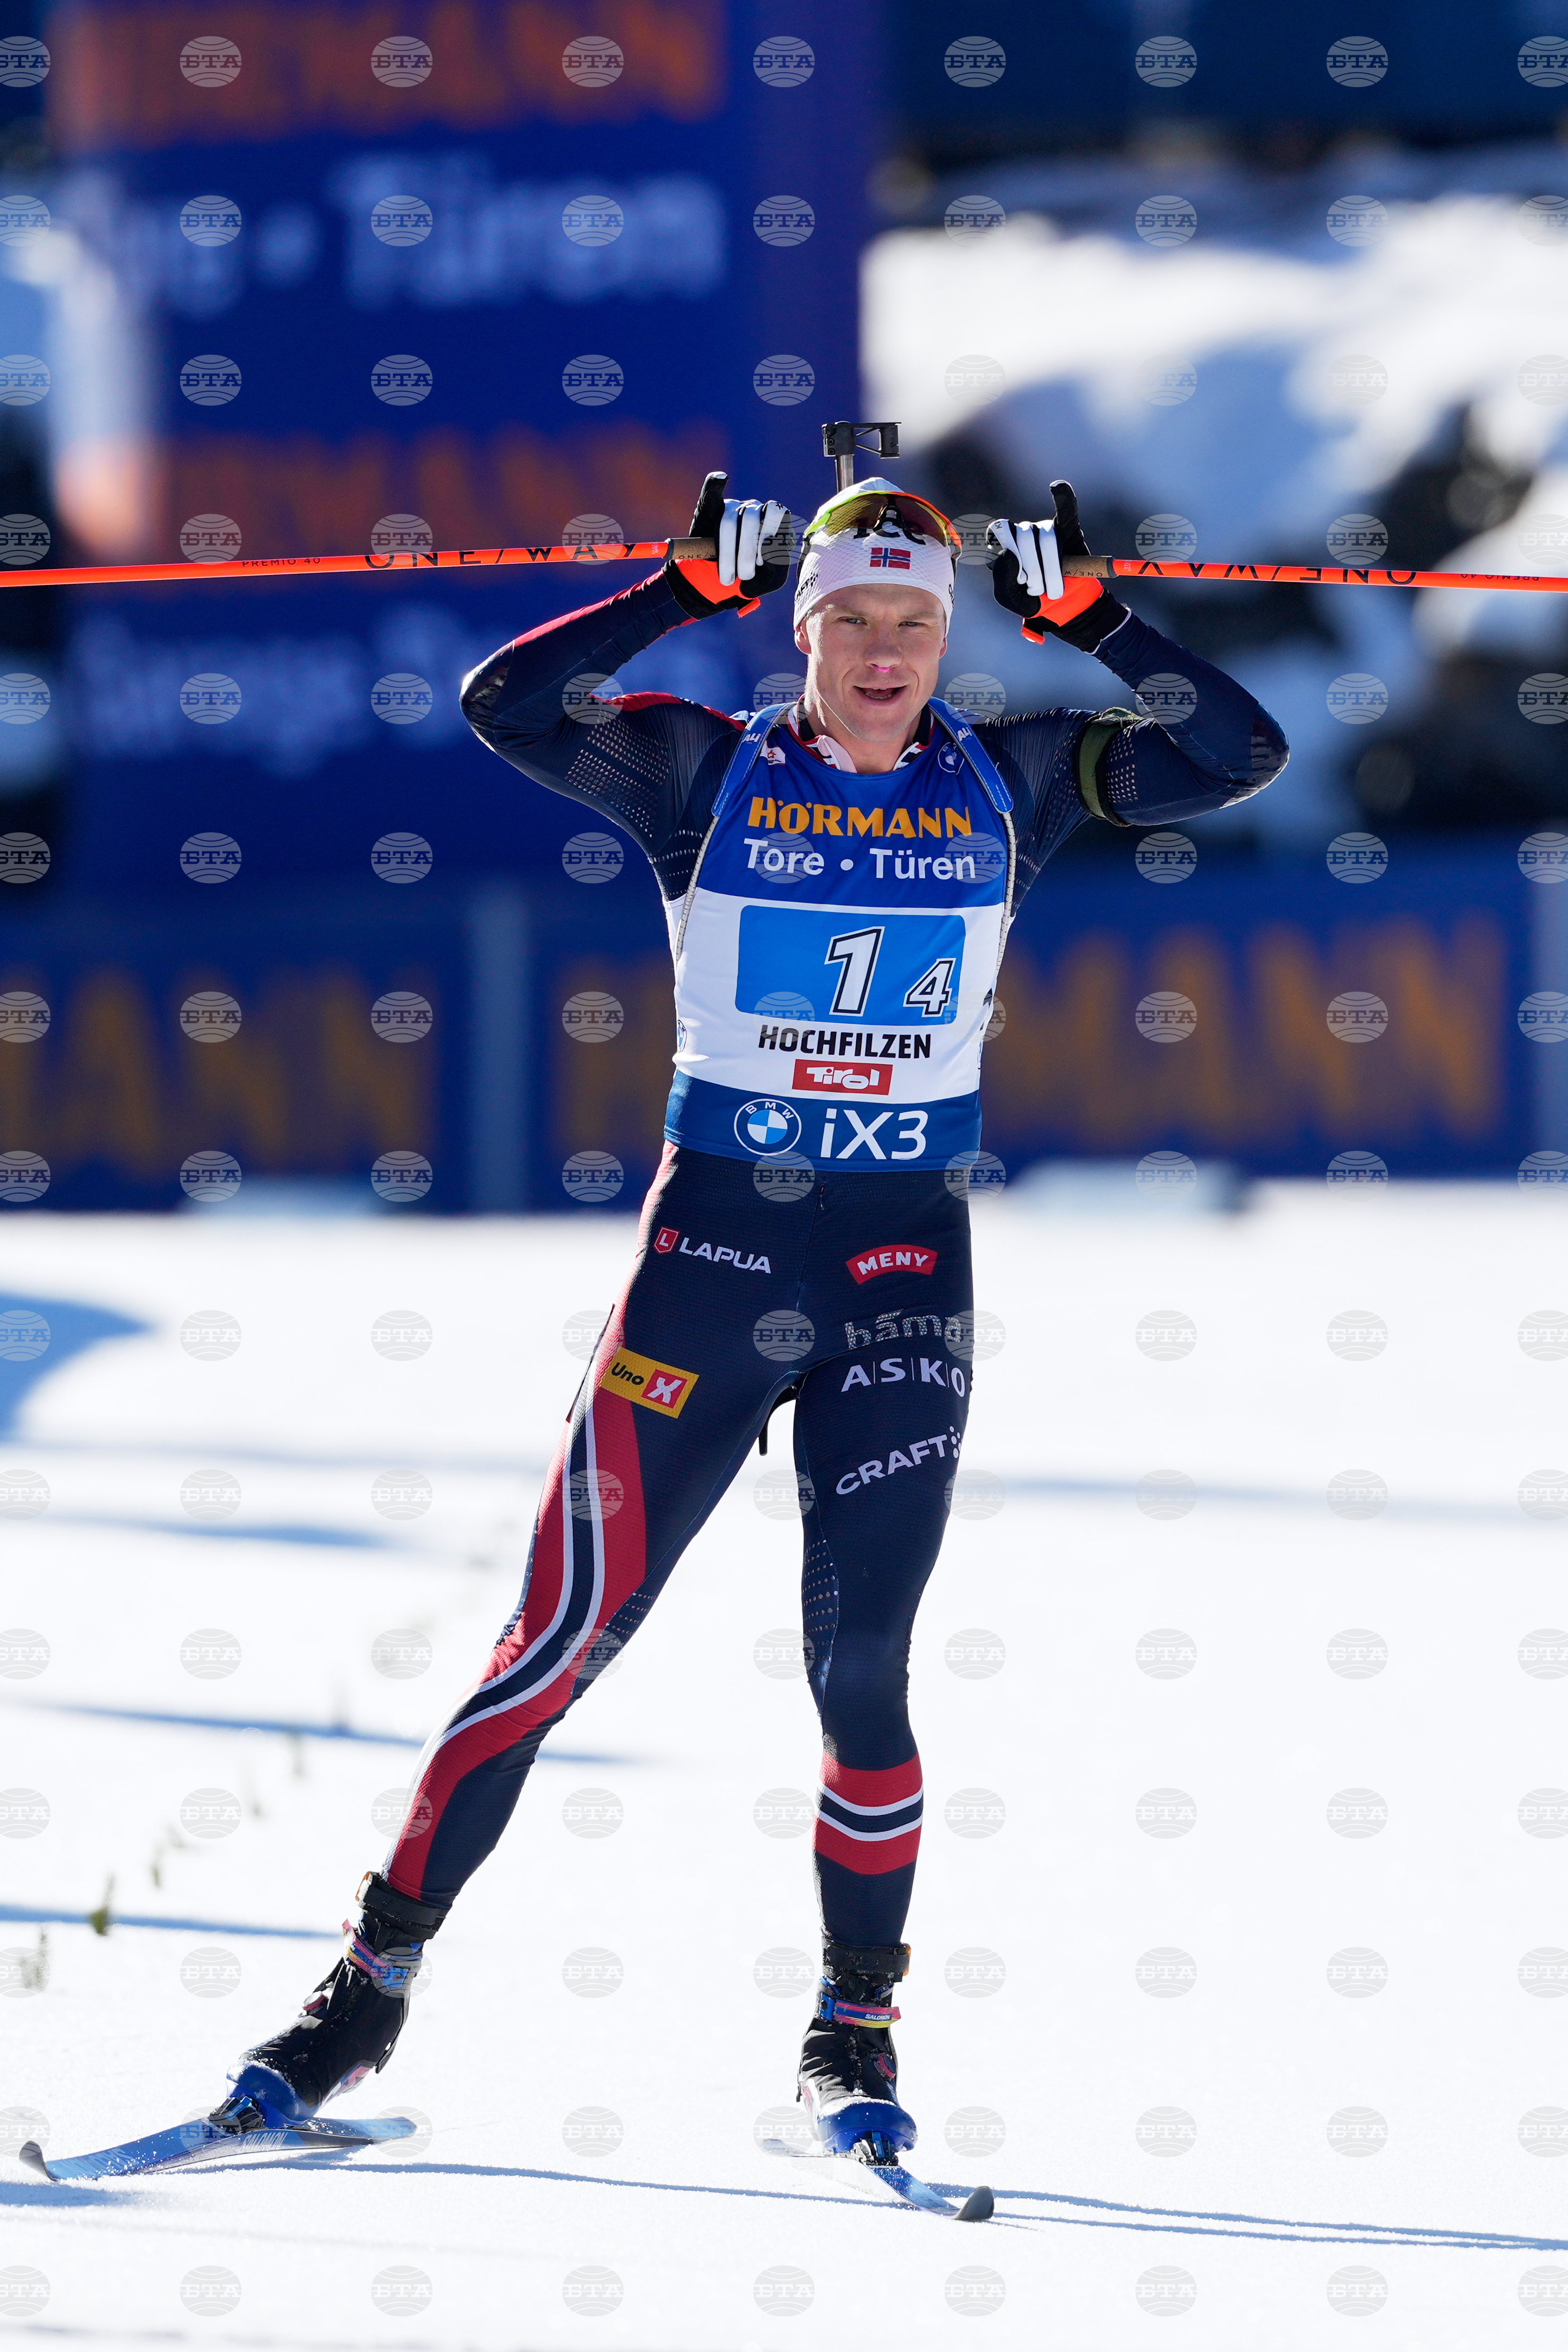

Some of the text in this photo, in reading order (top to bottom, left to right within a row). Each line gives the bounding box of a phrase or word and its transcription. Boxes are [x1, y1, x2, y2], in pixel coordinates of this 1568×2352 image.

[242, 559, 297, 567] PREMIO
[747, 796, 972, 838] HÖRMANN
[744, 838, 976, 880] Tore Türen
[824, 926, 956, 1018] 1 4
[759, 1024, 931, 1058] HOCHFILZEN
[806, 1066, 880, 1089] Tirol
[745, 1101, 795, 1119] BMW
[821, 1108, 928, 1160] iX3
[679, 1237, 771, 1274] LAPUA
[857, 1252, 929, 1275] MENY
[611, 1362, 683, 1404] Uno X
[836, 1434, 947, 1495] CRAFT
